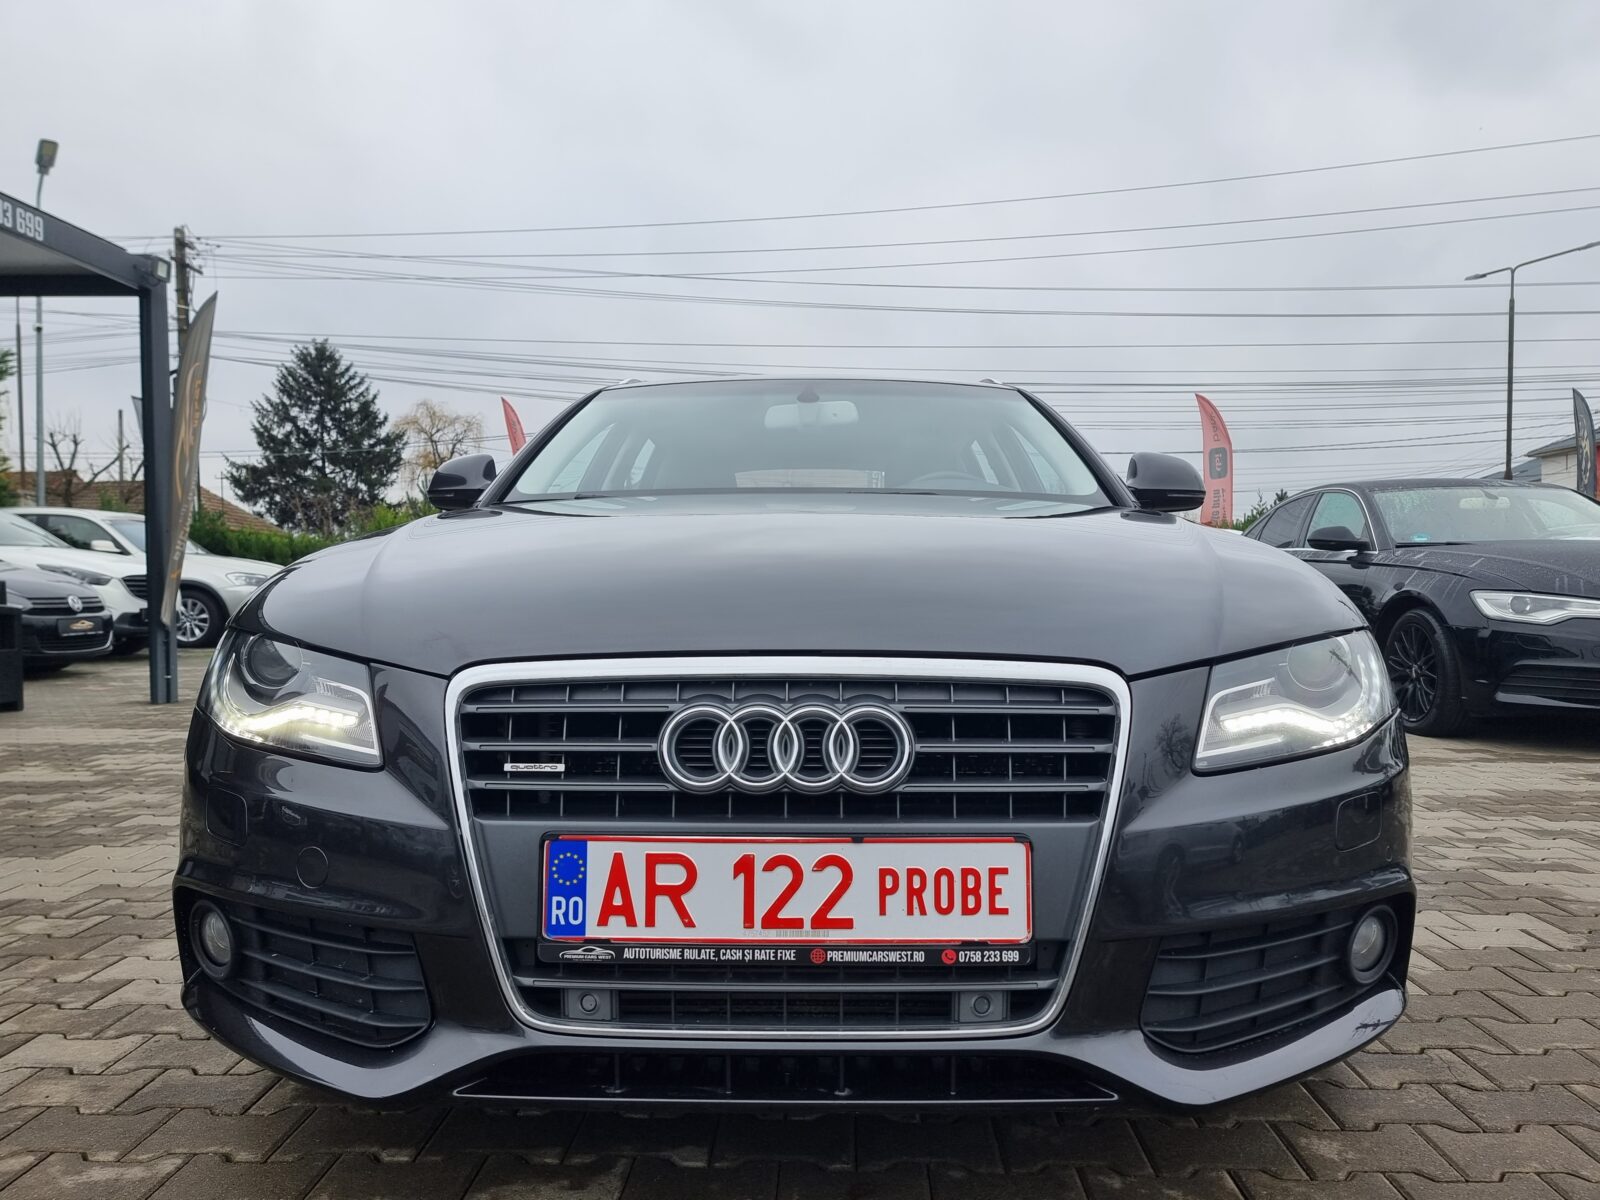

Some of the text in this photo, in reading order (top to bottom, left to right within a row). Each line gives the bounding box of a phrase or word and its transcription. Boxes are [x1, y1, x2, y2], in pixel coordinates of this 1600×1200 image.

[16, 206, 44, 241] 699
[596, 851, 1010, 930] AR 122 PROBE
[551, 896, 584, 926] RO
[623, 947, 682, 960] AUTOTURISME
[684, 948, 718, 961] RULATE,
[720, 949, 742, 960] CASH
[755, 949, 776, 960] RATE
[778, 950, 796, 961] FIXE
[826, 950, 925, 963] PREMIUMCARSWEST.RO
[958, 950, 1020, 963] 0758 233 699
